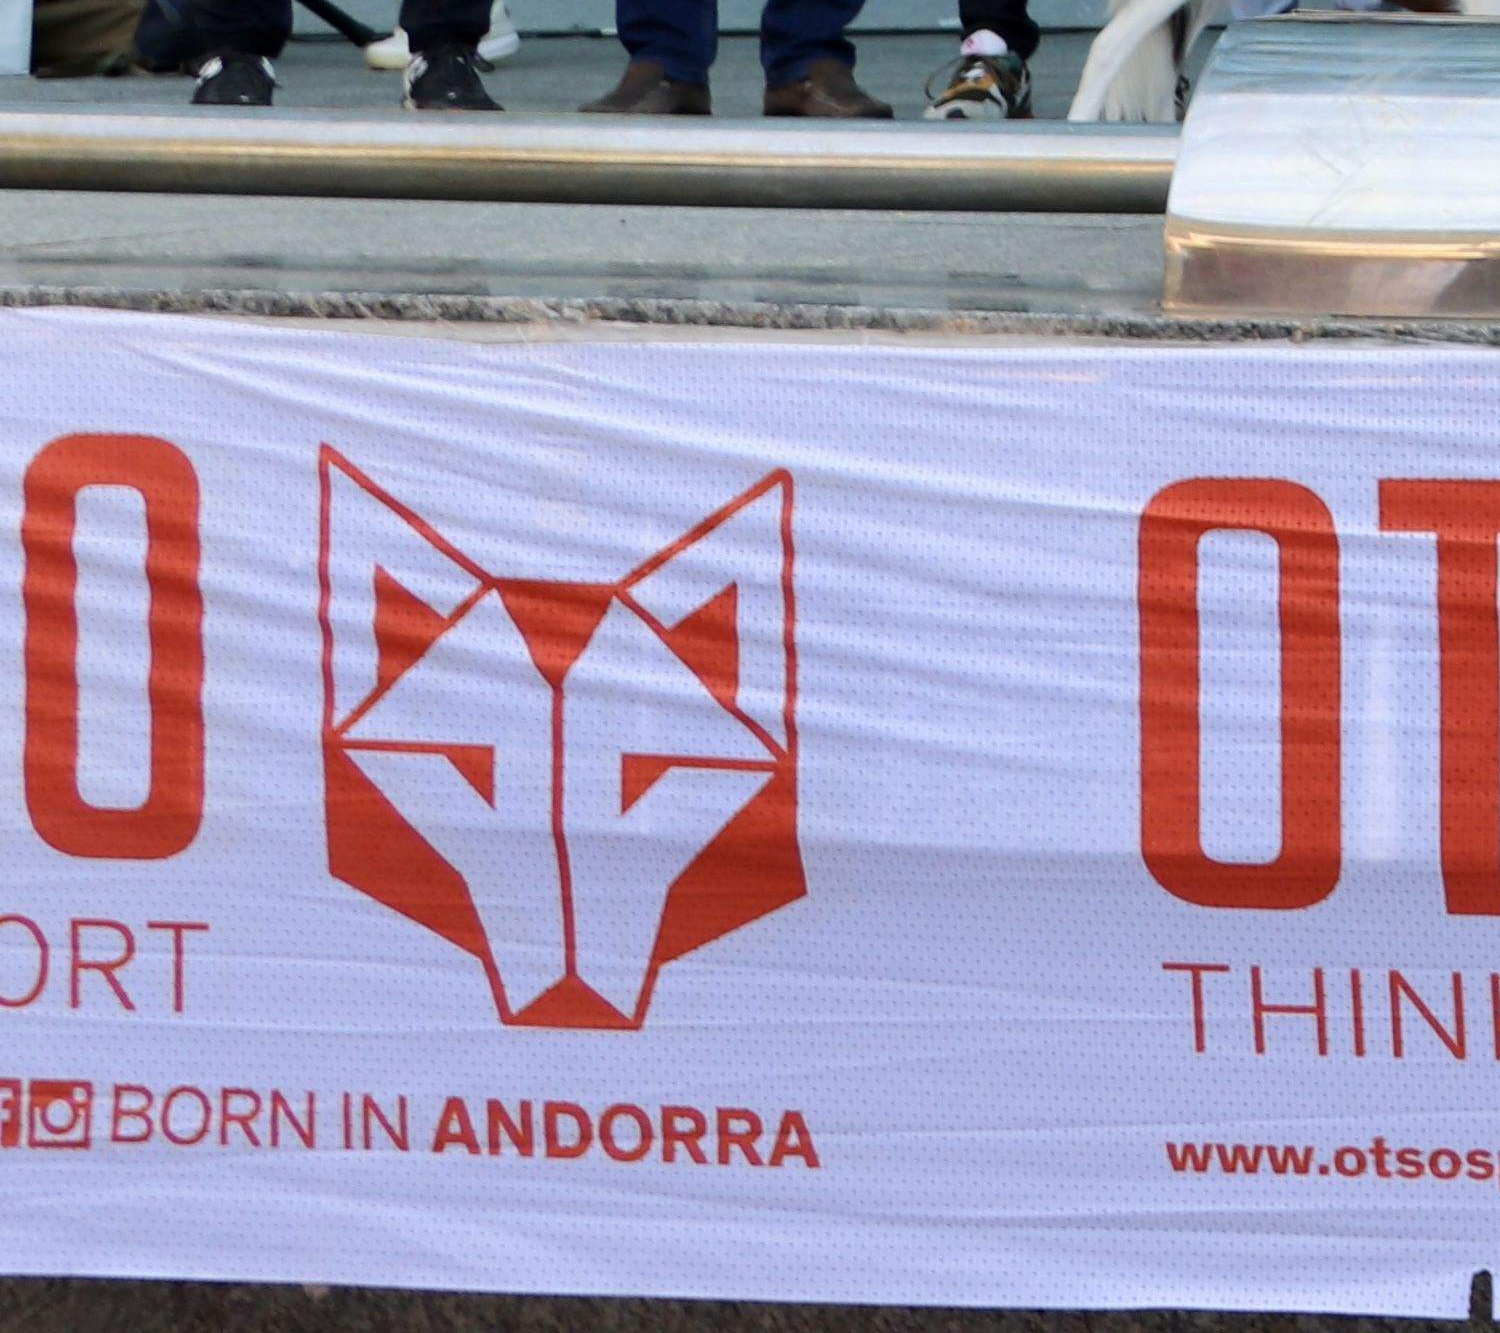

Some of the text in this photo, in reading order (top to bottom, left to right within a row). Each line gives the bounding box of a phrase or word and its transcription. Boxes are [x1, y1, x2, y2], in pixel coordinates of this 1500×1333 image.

[110, 1083, 822, 1169] BORN IN ANDORRA
